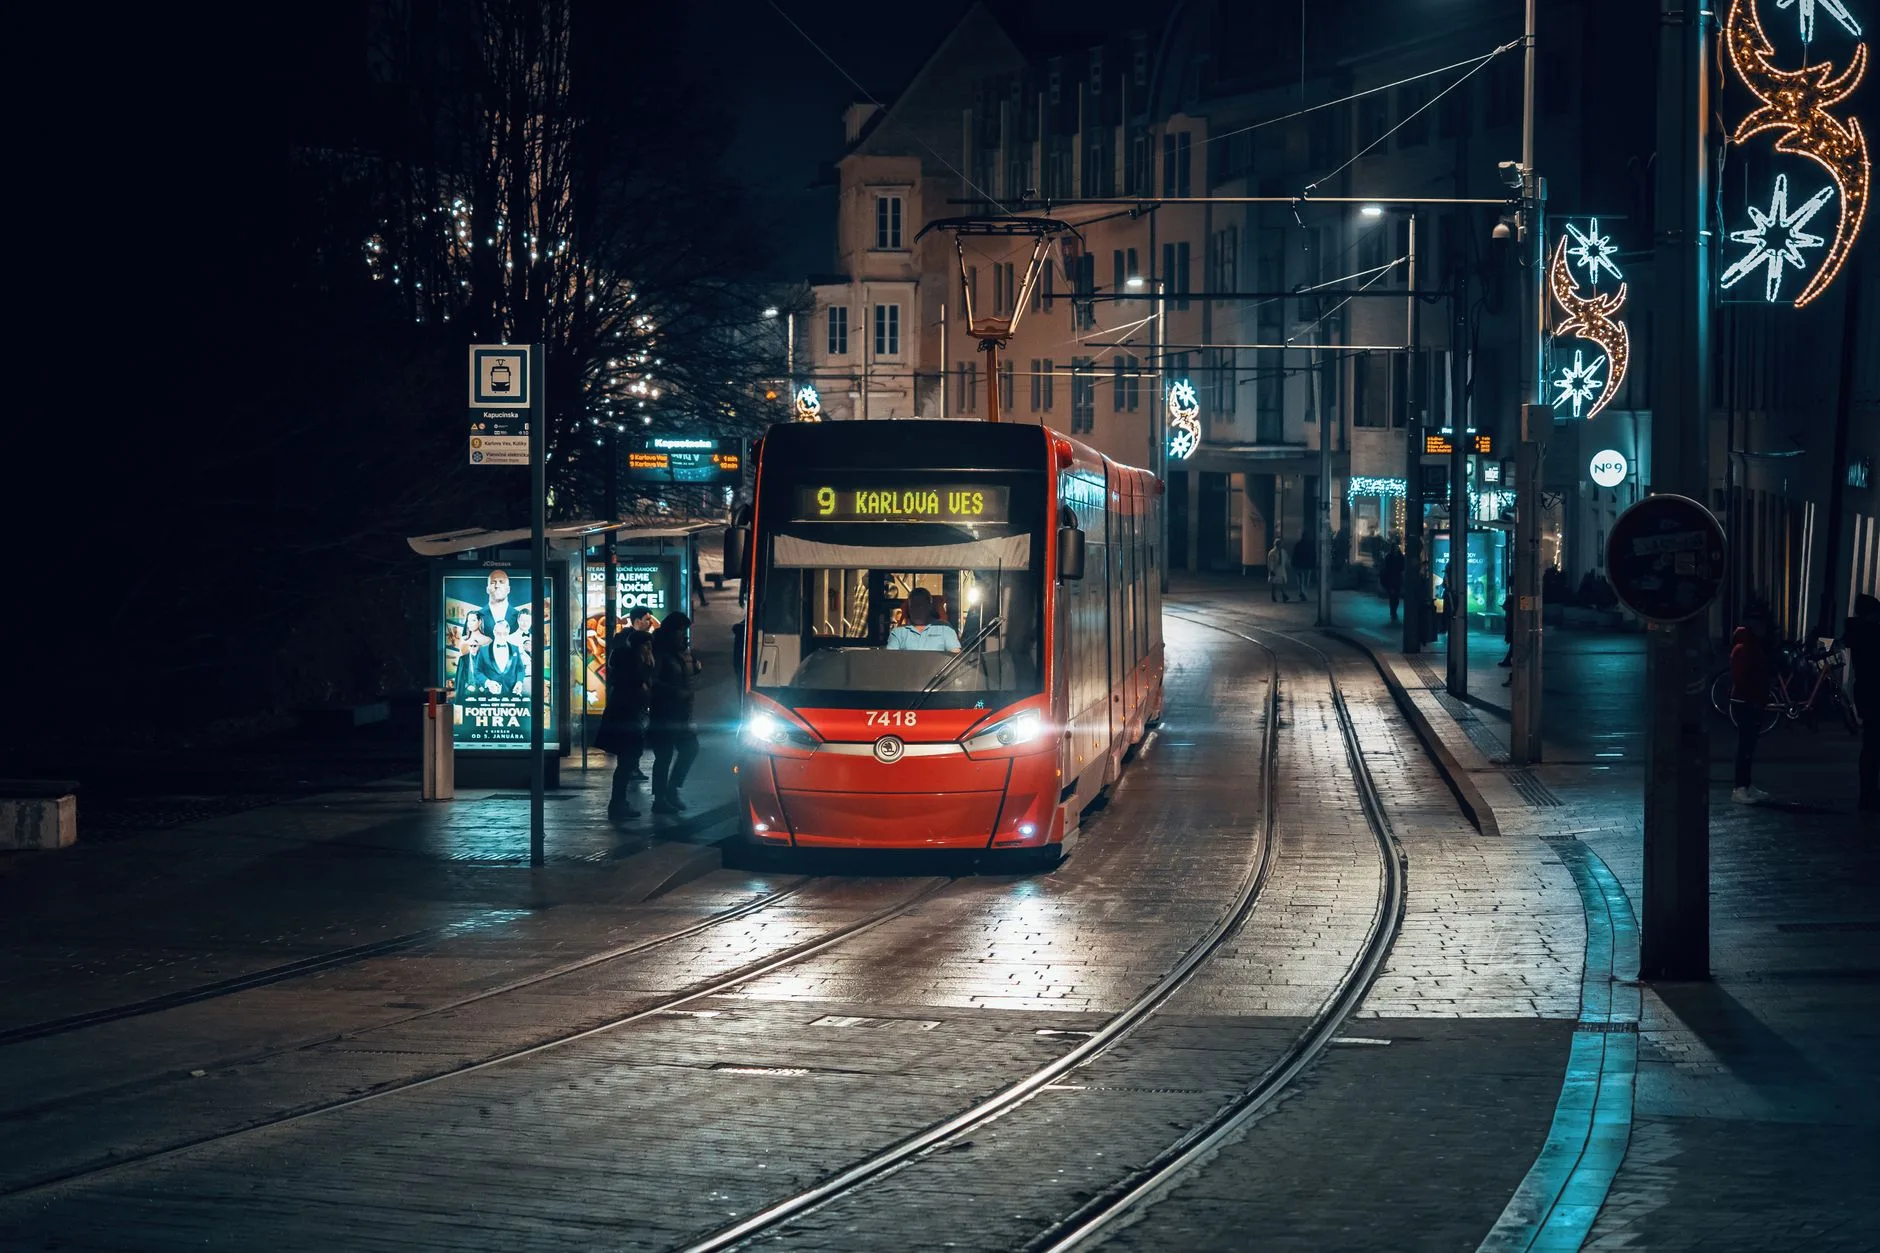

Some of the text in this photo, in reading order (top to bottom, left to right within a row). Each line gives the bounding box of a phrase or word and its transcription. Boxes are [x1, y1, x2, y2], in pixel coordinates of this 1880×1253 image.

[817, 487, 984, 515] 9 KARLOVÁ VES
[465, 707, 531, 717] FORTUNOVA
[475, 717, 520, 727] HRA
[865, 711, 917, 727] 7418
